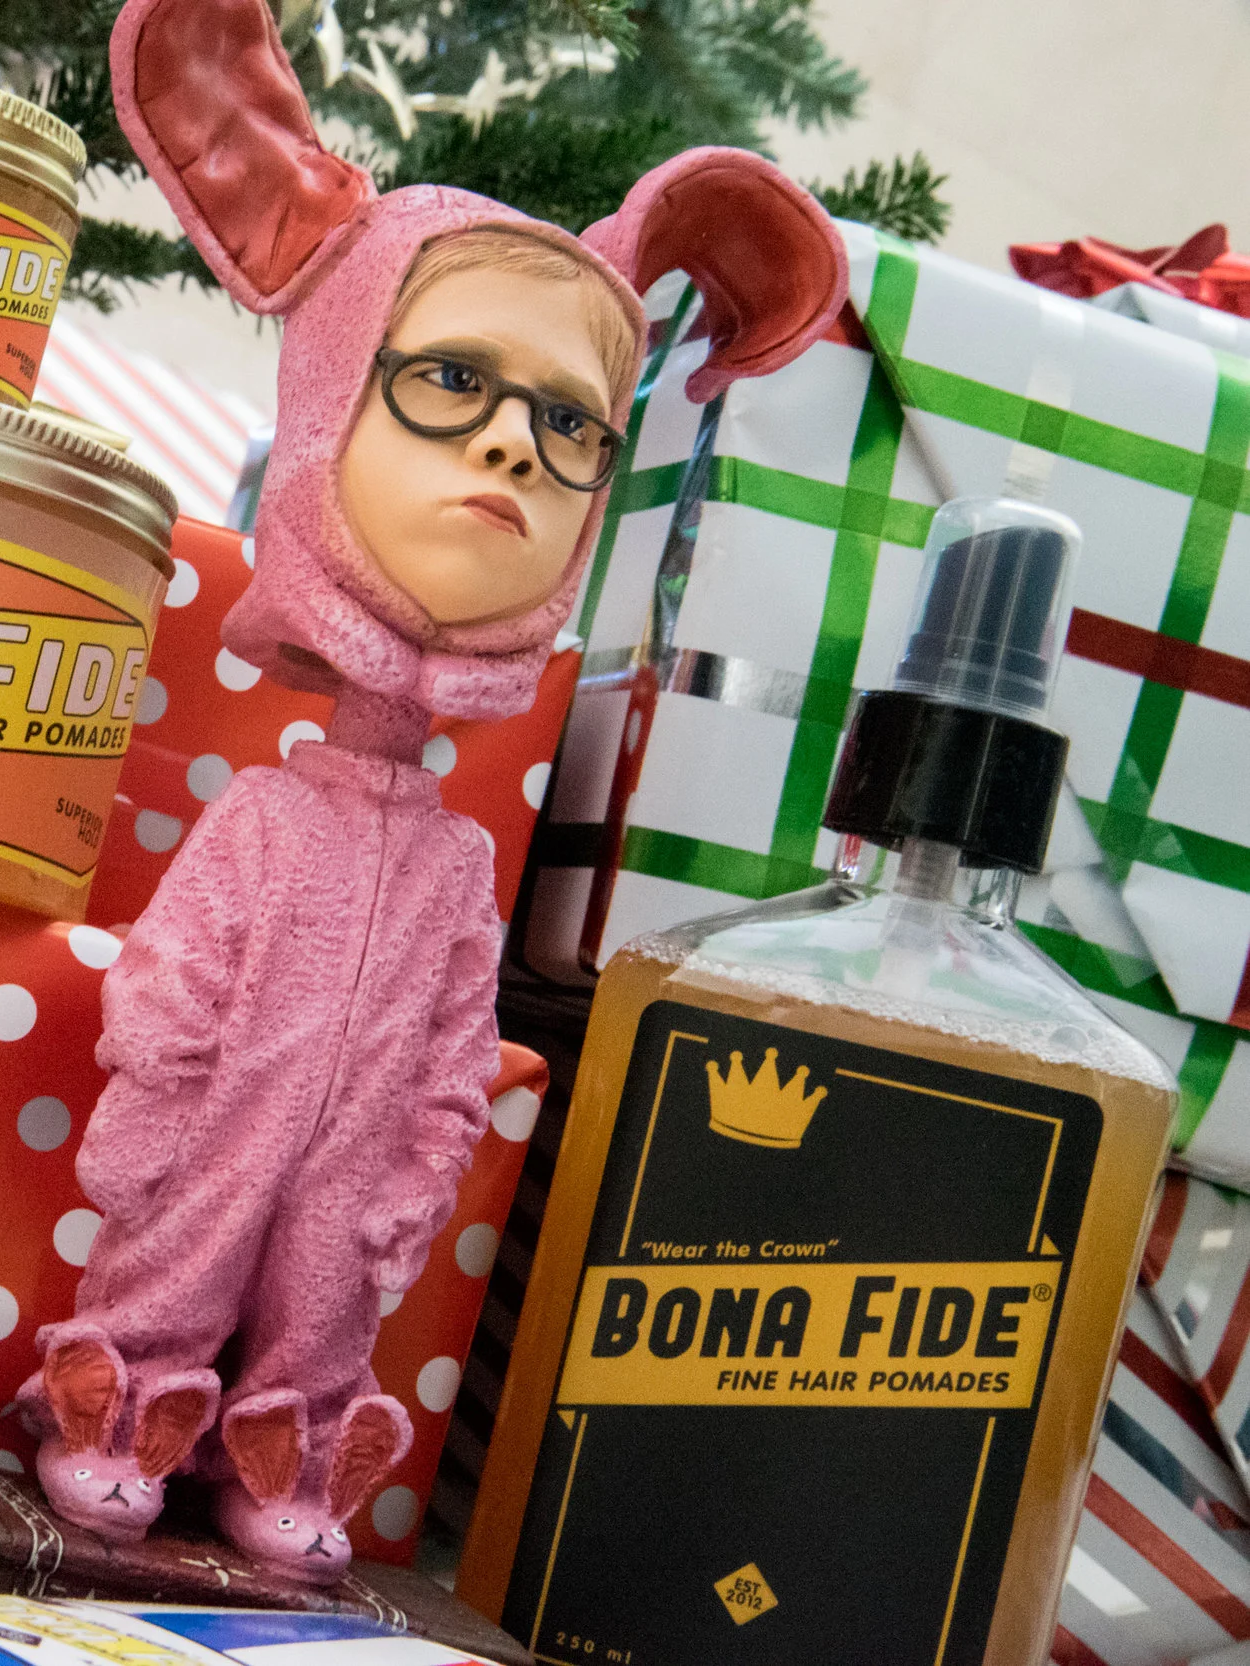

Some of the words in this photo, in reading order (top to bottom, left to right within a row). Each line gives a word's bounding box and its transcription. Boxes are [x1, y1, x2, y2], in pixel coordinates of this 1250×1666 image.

[24, 721, 126, 749] POMADES
[716, 1240, 751, 1259] the
[591, 1277, 813, 1359] BONA
[717, 1370, 778, 1391] FINE
[789, 1371, 857, 1392] HAIR
[868, 1371, 1010, 1393] POMADES
[734, 1578, 761, 1596] EST
[725, 1588, 763, 1610] 2012
[556, 1631, 595, 1653] 250
